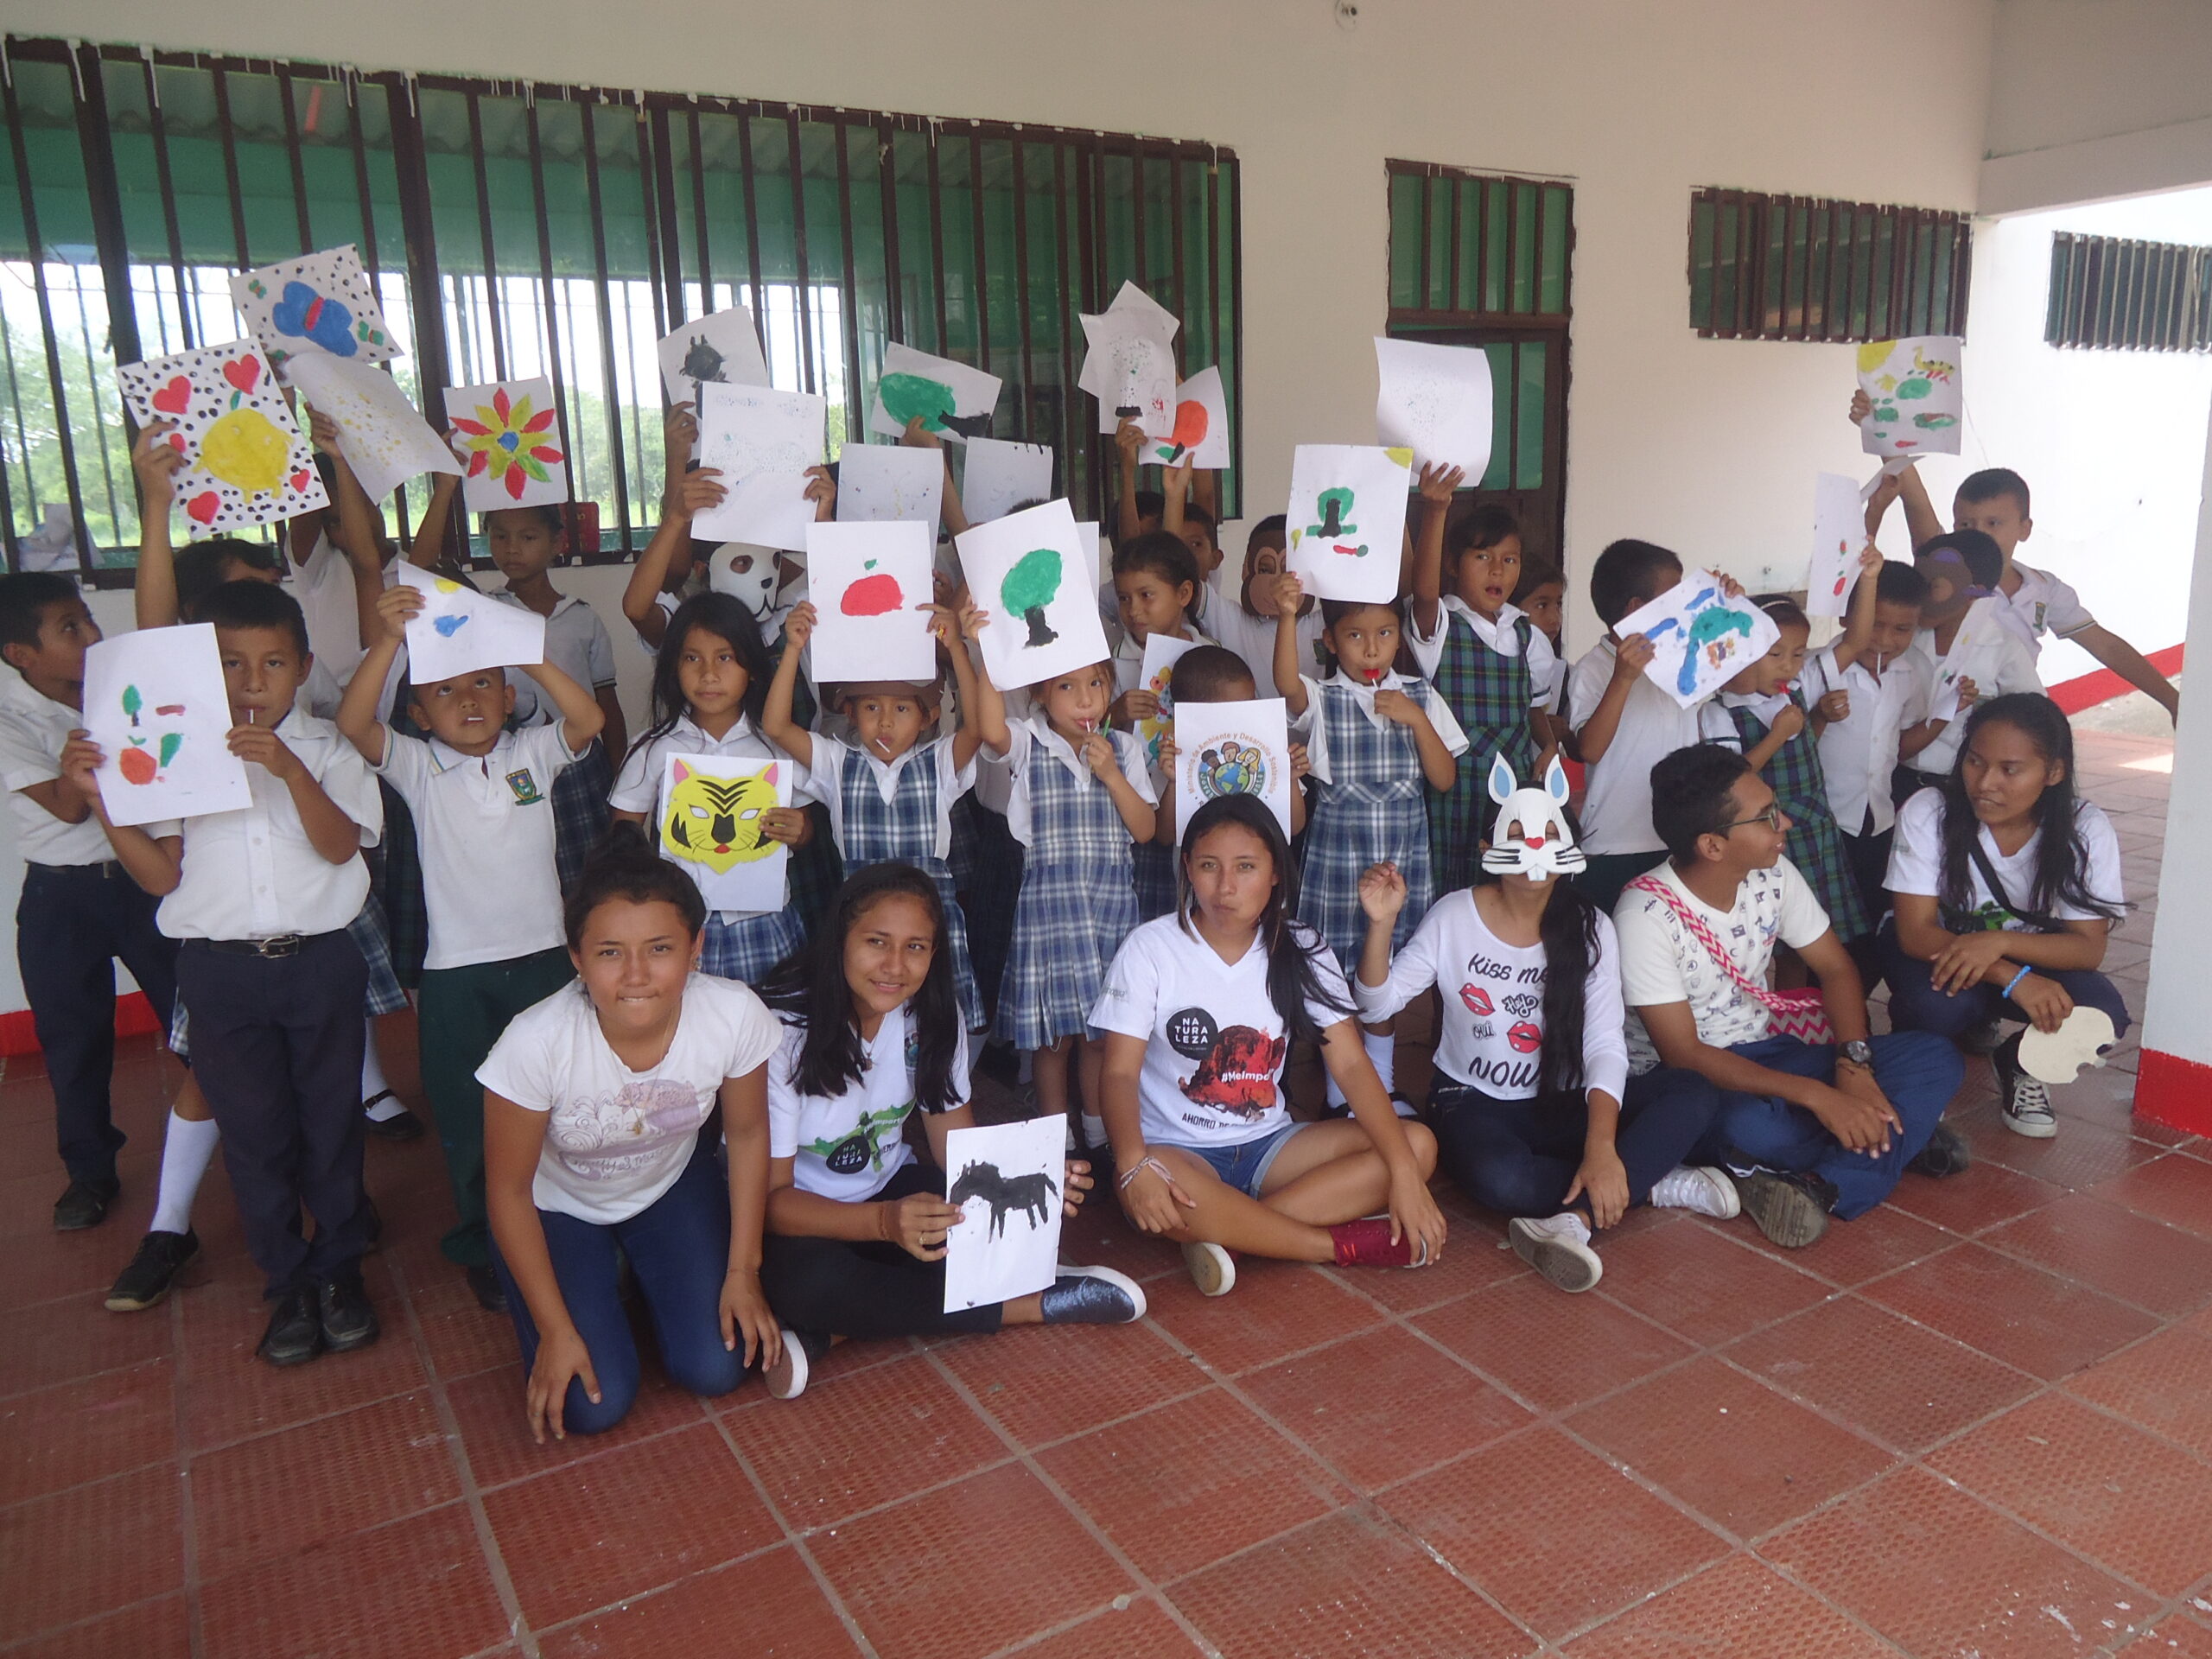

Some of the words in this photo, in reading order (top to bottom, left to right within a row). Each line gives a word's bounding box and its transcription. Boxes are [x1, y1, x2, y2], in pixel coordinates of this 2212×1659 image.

[1198, 733, 1231, 751] Ambiente
[1239, 733, 1272, 757] Desarrollo
[1468, 952, 1512, 981] Kiss
[1182, 1017, 1199, 1026] NA
[1174, 1026, 1208, 1035] TURA
[1175, 1034, 1208, 1045] LEZA
[1221, 1068, 1274, 1084] #MeImpo
[1468, 1056, 1541, 1088] NOW
[1182, 1113, 1216, 1129] AHORRO
